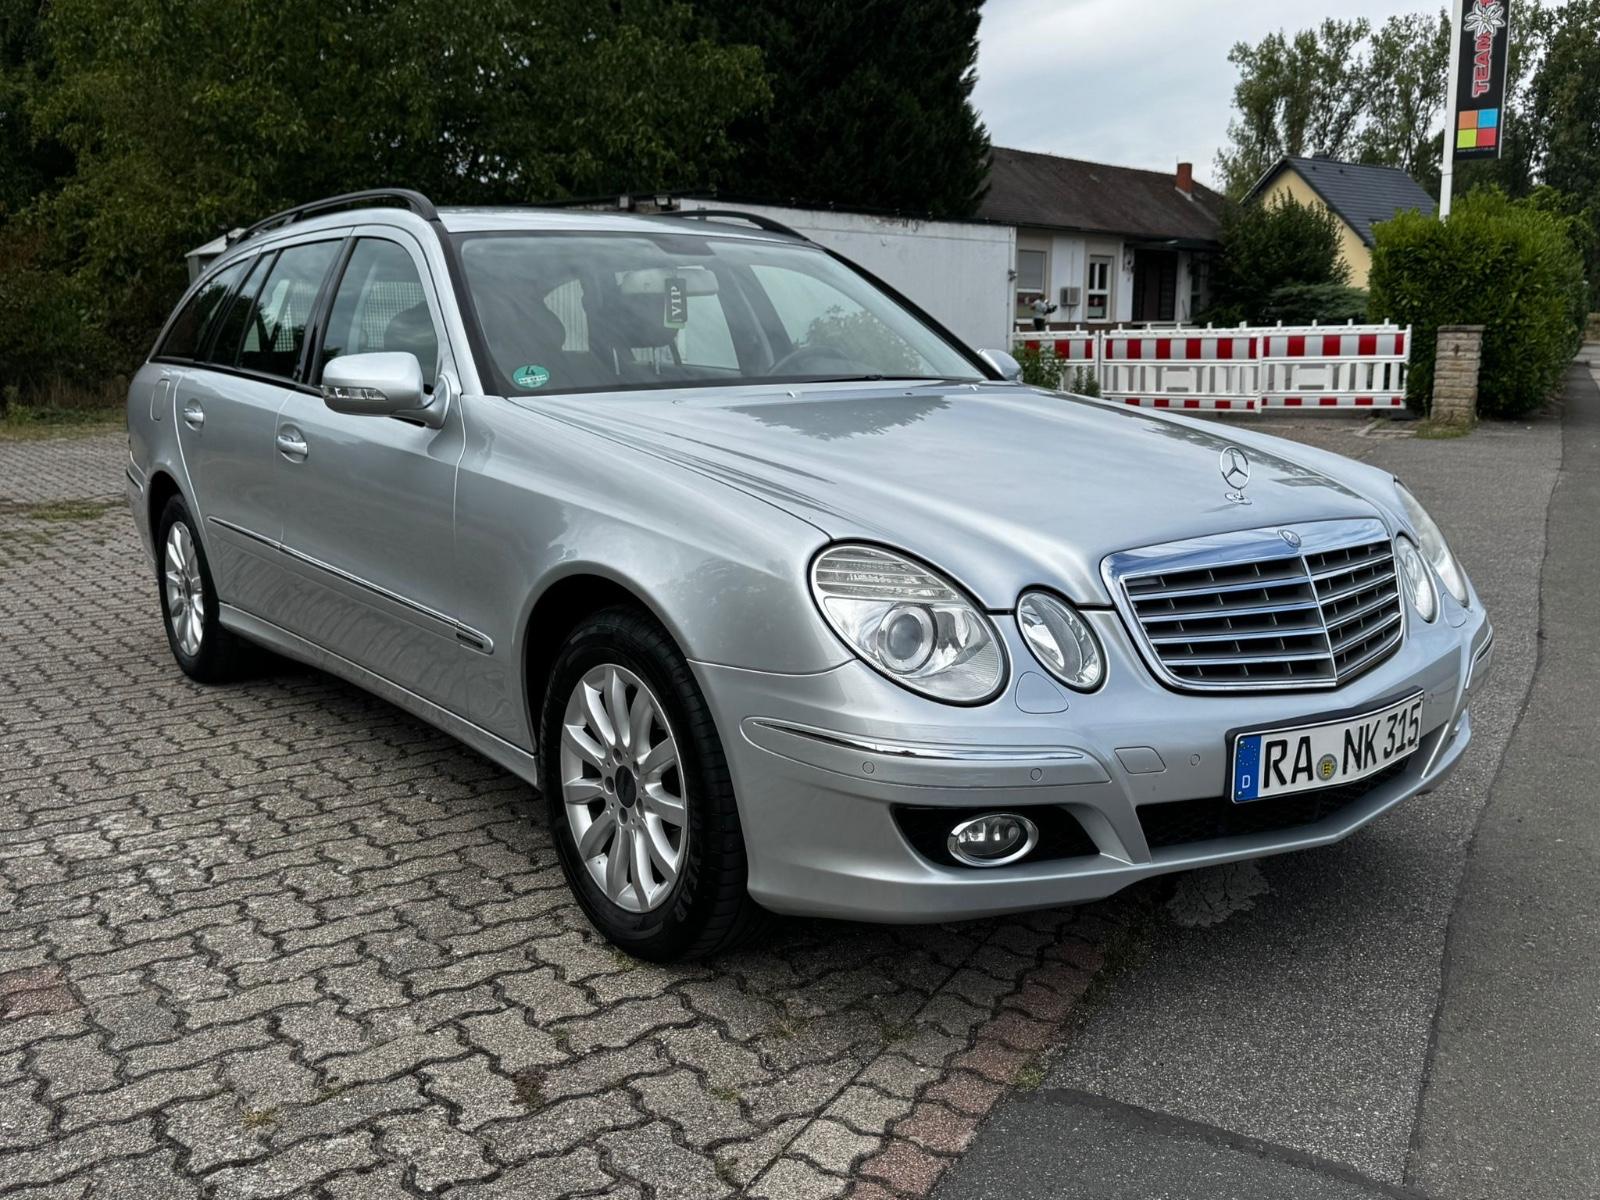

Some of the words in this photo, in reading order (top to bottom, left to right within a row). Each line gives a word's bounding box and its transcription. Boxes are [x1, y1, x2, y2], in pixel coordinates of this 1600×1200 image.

[1472, 31, 1493, 98] TEAM
[671, 286, 682, 316] VIP
[525, 366, 536, 376] 4
[1263, 735, 1314, 789] RA
[1342, 719, 1381, 775] NK
[1383, 702, 1421, 760] 315
[1242, 774, 1251, 789] D
